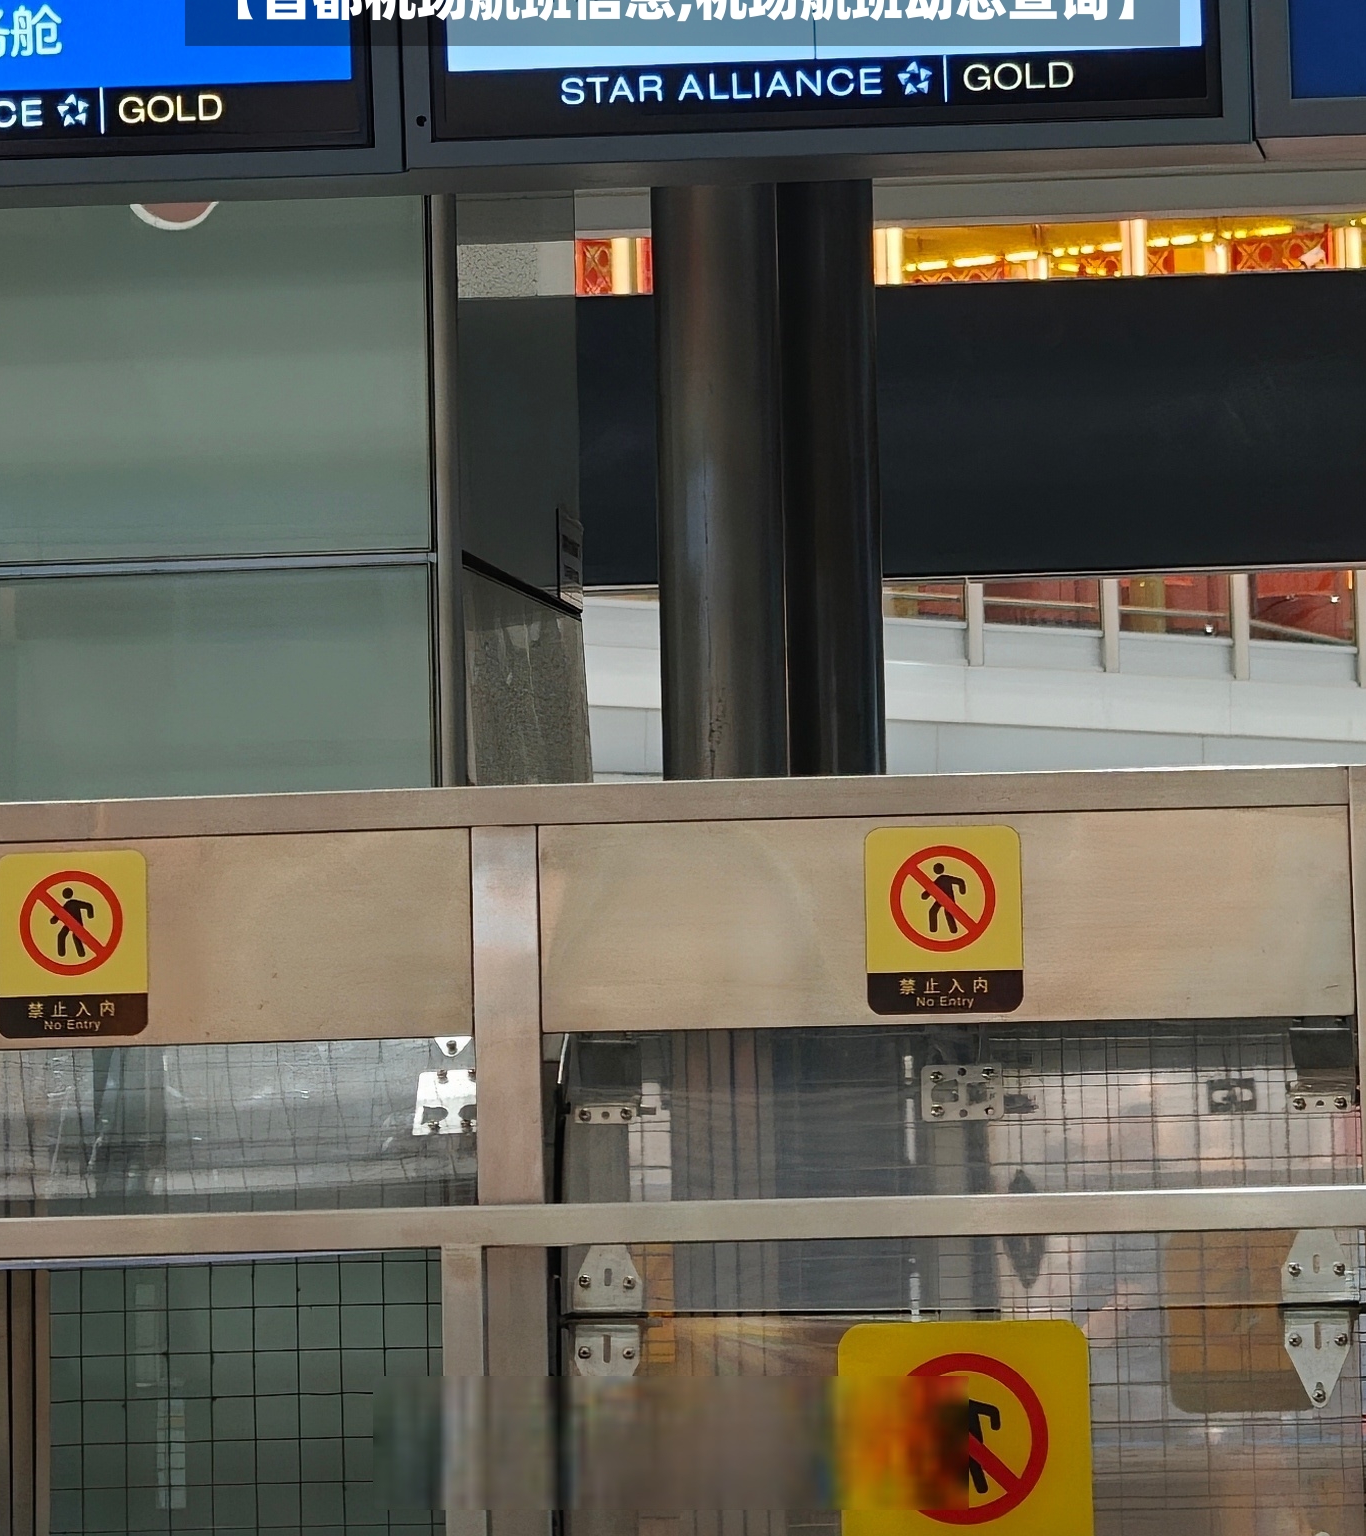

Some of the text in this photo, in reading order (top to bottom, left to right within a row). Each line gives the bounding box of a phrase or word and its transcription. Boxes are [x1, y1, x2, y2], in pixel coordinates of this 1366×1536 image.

[562, 62, 1073, 104] STAR ALLIANCE GOLD
[119, 94, 222, 123] GOLD
[899, 977, 988, 995] 禁止入内
[27, 999, 115, 1018] 禁止入内
[916, 996, 974, 1009] No Entry
[44, 1020, 101, 1031] No Entry
